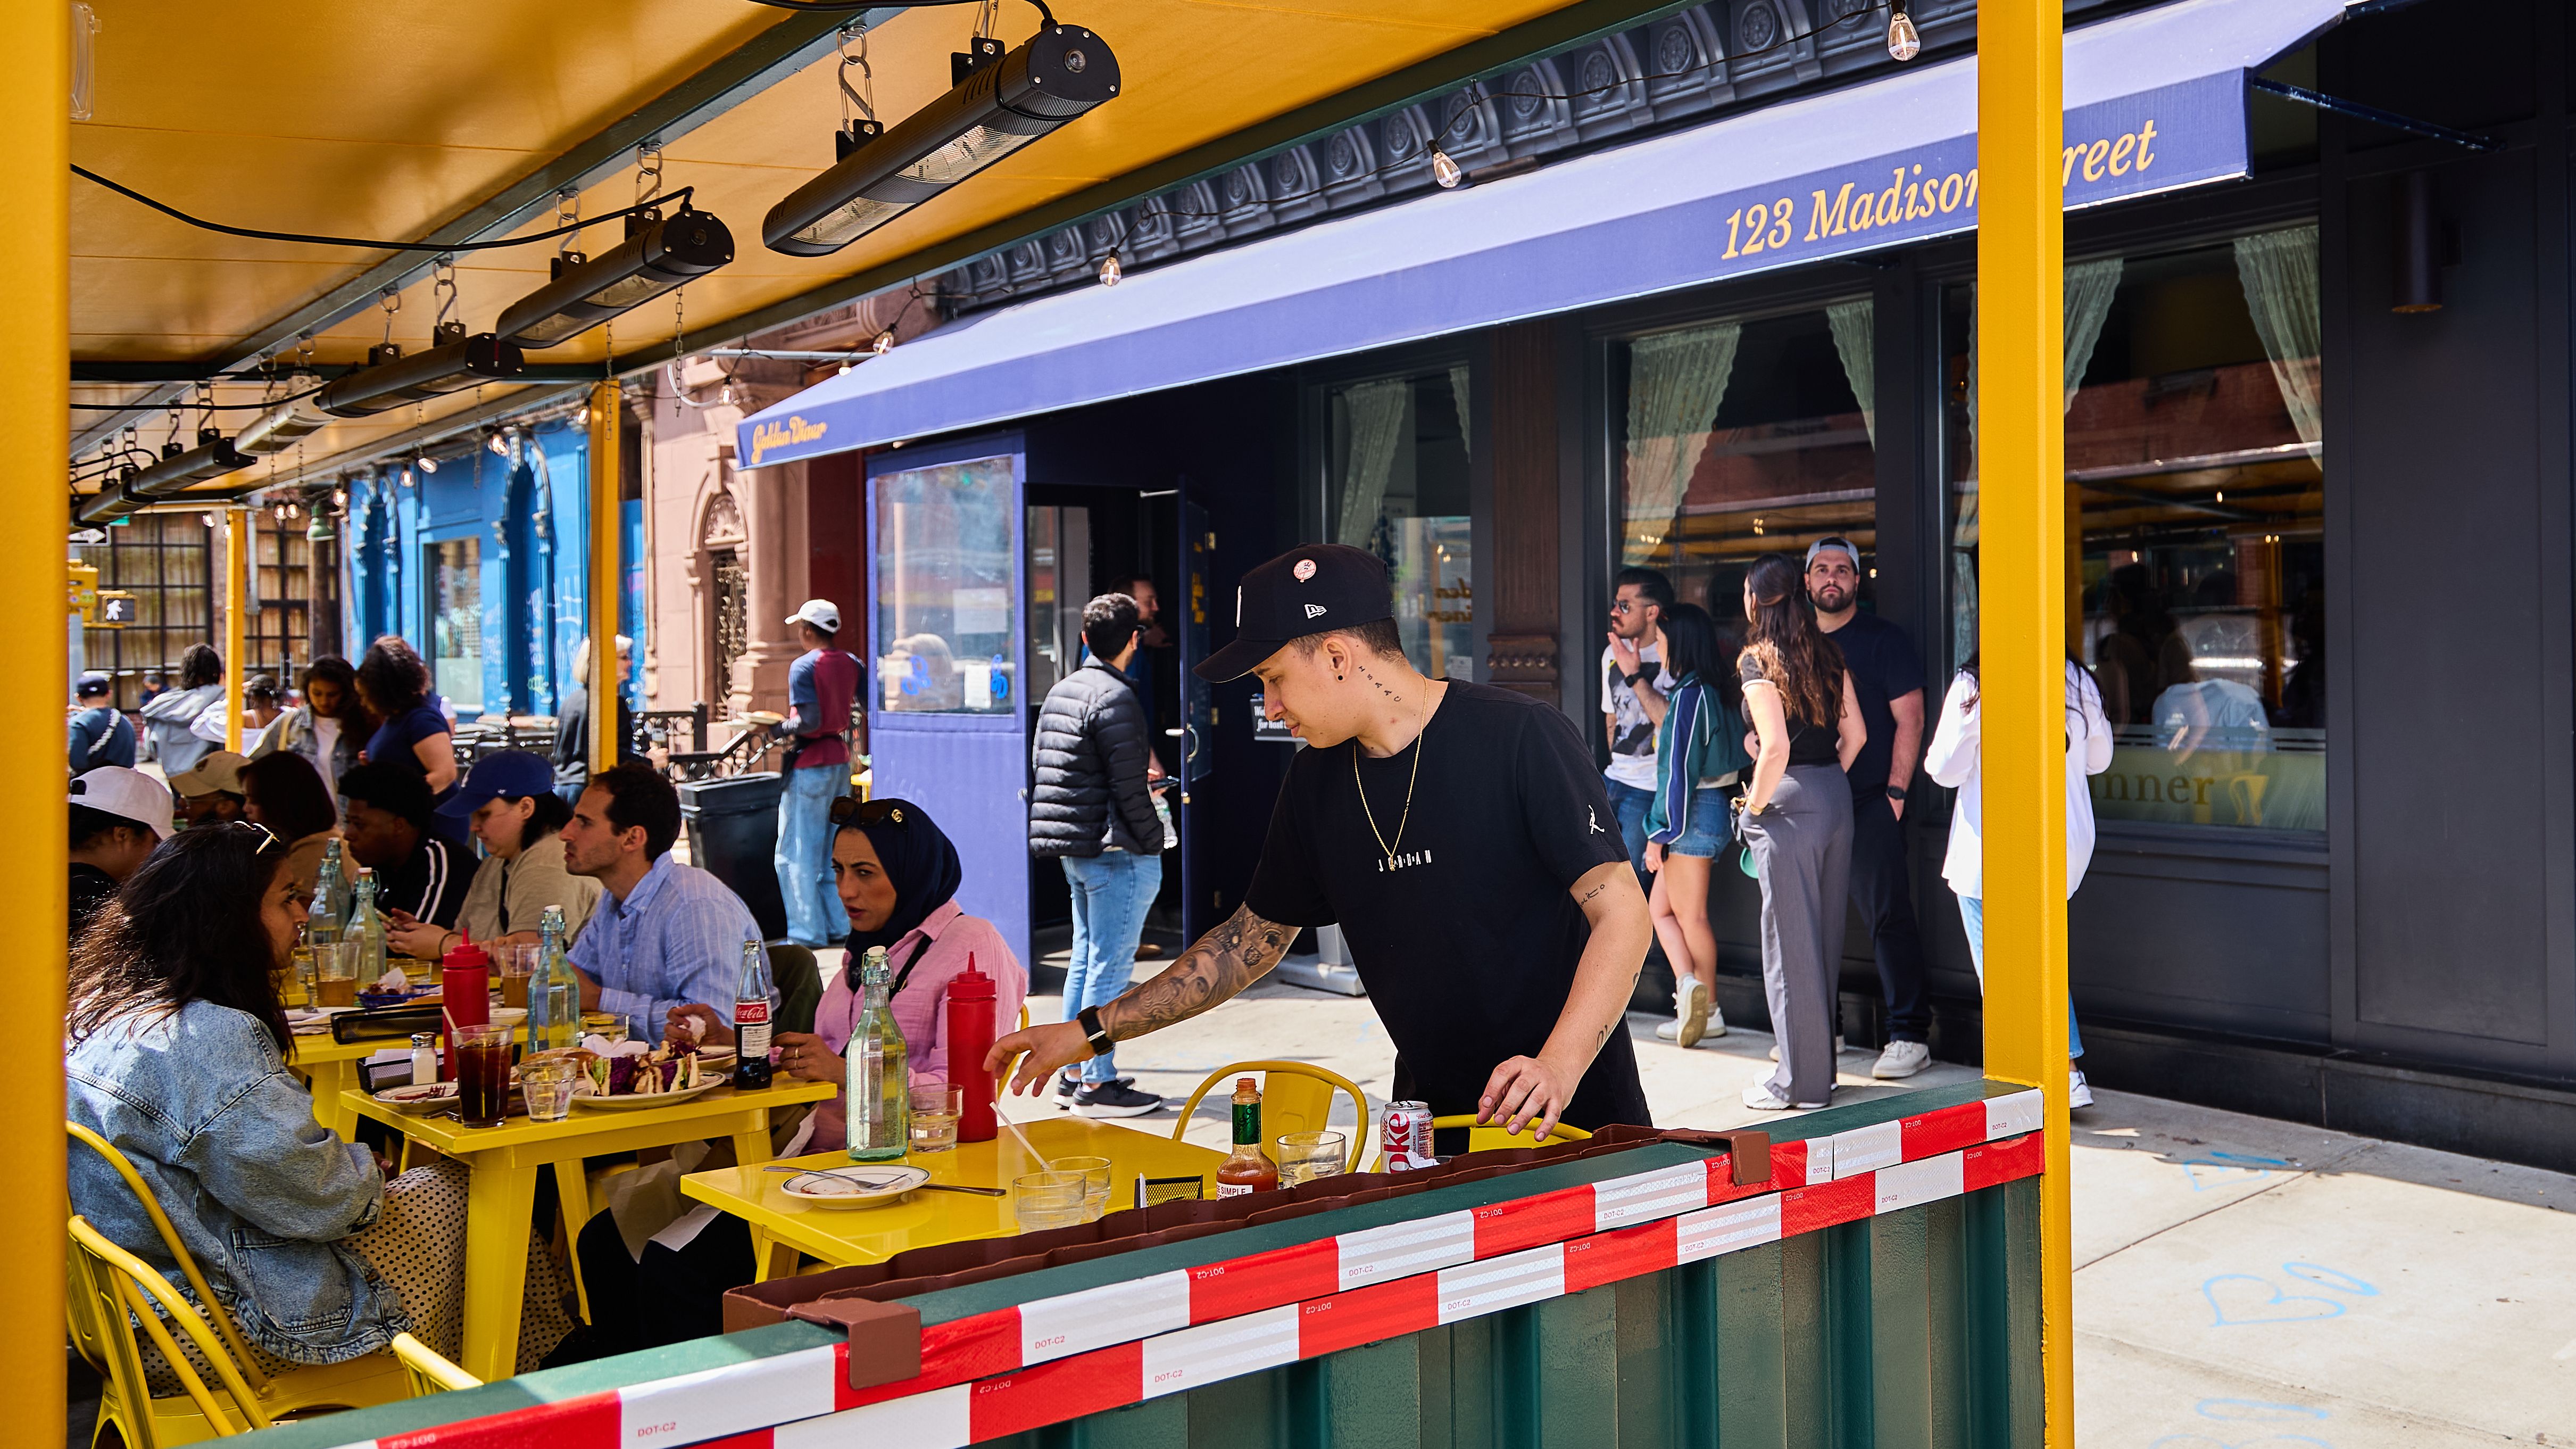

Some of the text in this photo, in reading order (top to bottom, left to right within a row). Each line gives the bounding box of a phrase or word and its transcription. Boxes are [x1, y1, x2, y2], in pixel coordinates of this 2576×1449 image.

[1721, 197, 1793, 260] 123
[2063, 120, 2157, 187] reet
[751, 416, 828, 464] Golden Diner
[1358, 666, 1401, 702] ISAAC
[1256, 718, 1268, 732] for
[1268, 720, 1284, 729] host
[2088, 773, 2215, 806] nner
[1905, 1120, 1922, 1129] DOT-C2
[1384, 1113, 1410, 1173] oke
[1967, 1151, 1982, 1160] DOT-C2
[1711, 1159, 1731, 1169] DOT-C2
[1785, 1193, 1804, 1202] DOT-C2
[1480, 1208, 1503, 1219] DOT-C2
[1604, 1210, 1624, 1219] DOT-C2
[1569, 1243, 1591, 1252] DOT-C2
[1685, 1243, 1704, 1252] DOT-C2
[1197, 1267, 1225, 1279] DOT-C2
[1349, 1265, 1373, 1276] DOT-C2
[1306, 1302, 1332, 1314] DOT-C2
[1448, 1299, 1470, 1310] DOT-C2
[1035, 1336, 1065, 1349] DOT-C2
[1155, 1370, 1183, 1382] DOT-C2
[979, 1380, 1011, 1394] DOT-C2
[638, 1422, 676, 1437] DOT-C2
